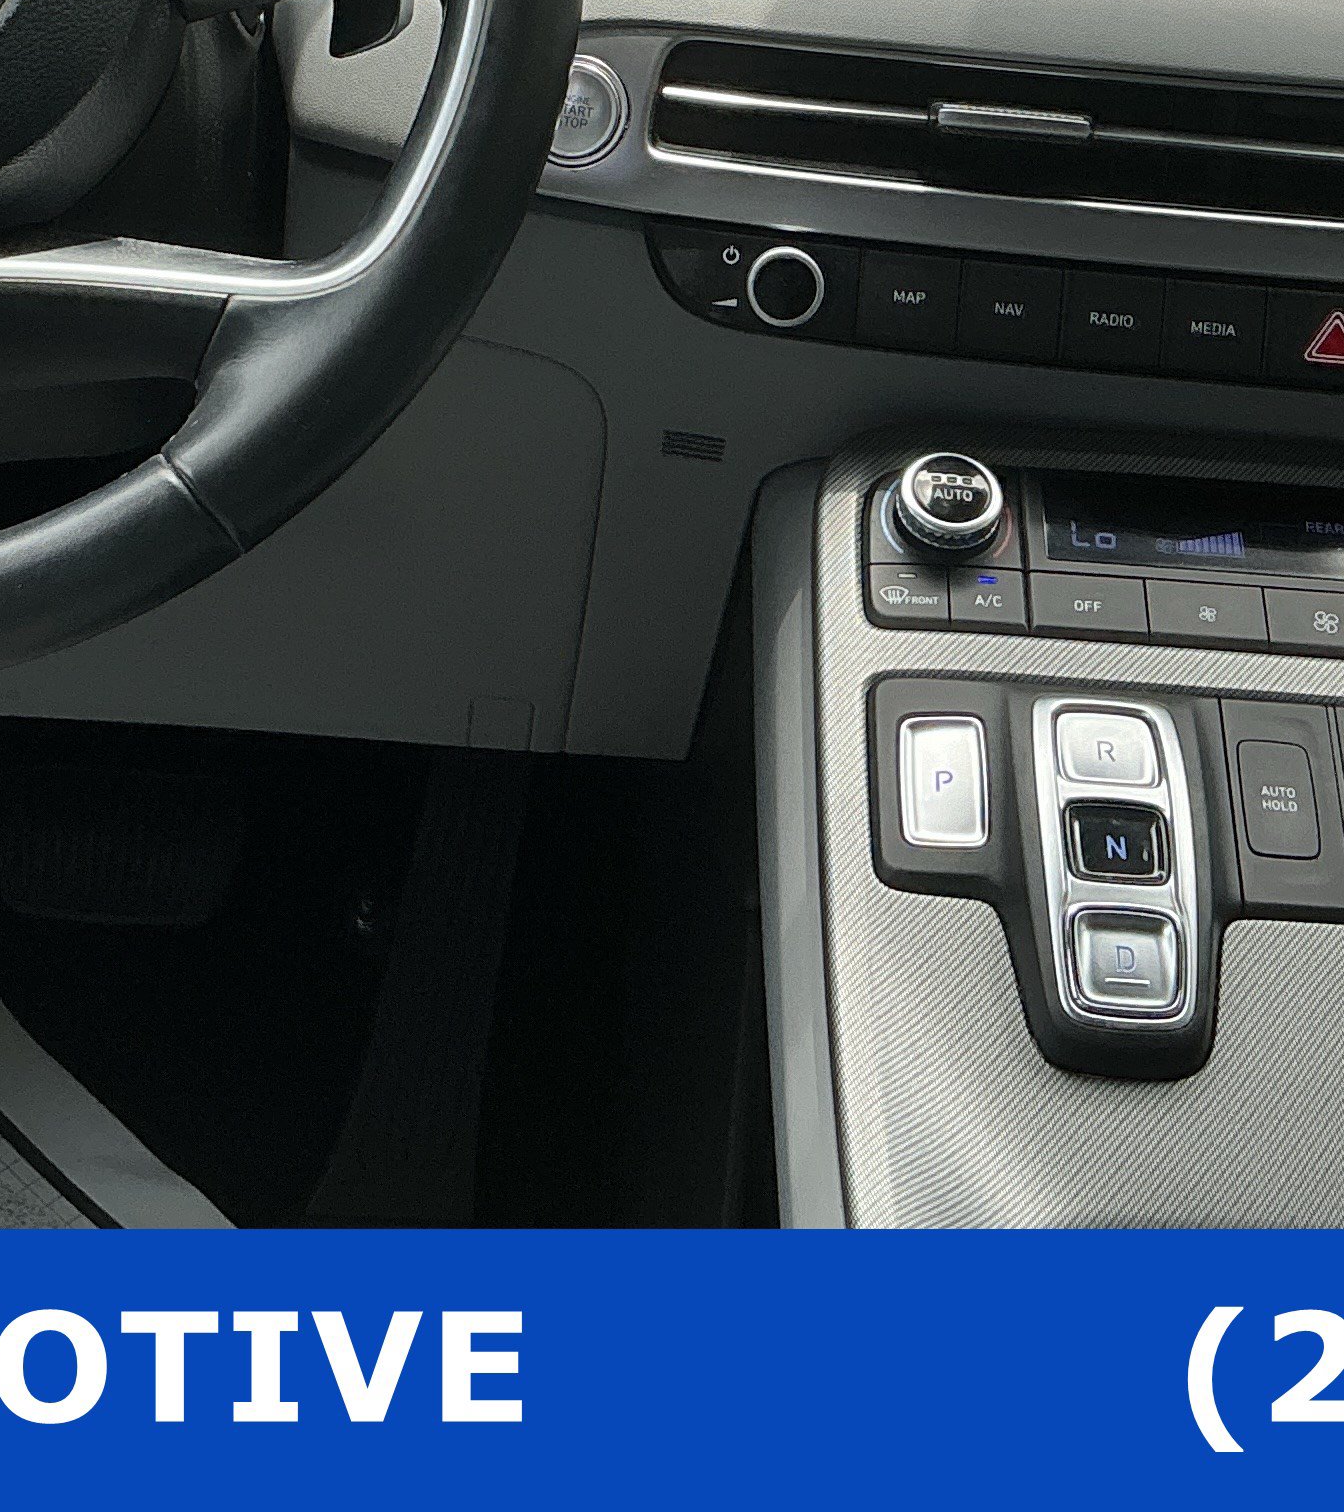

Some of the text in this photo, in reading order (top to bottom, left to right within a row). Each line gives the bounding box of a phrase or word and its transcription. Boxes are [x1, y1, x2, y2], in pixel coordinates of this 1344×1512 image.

[892, 289, 927, 306] MAP
[994, 301, 1024, 318] NAV
[1088, 311, 1135, 329] RADIO
[1190, 321, 1237, 339] MEDIA
[932, 487, 974, 503] AUTO
[906, 595, 939, 607] FRONT
[974, 593, 1003, 609] A/C
[1073, 599, 1103, 614] OFF
[1096, 740, 1116, 763] R
[935, 770, 954, 793] P
[1260, 785, 1297, 800] AUTO
[1262, 798, 1298, 814] HOLD
[1105, 834, 1128, 861] N
[1115, 946, 1136, 974] D
